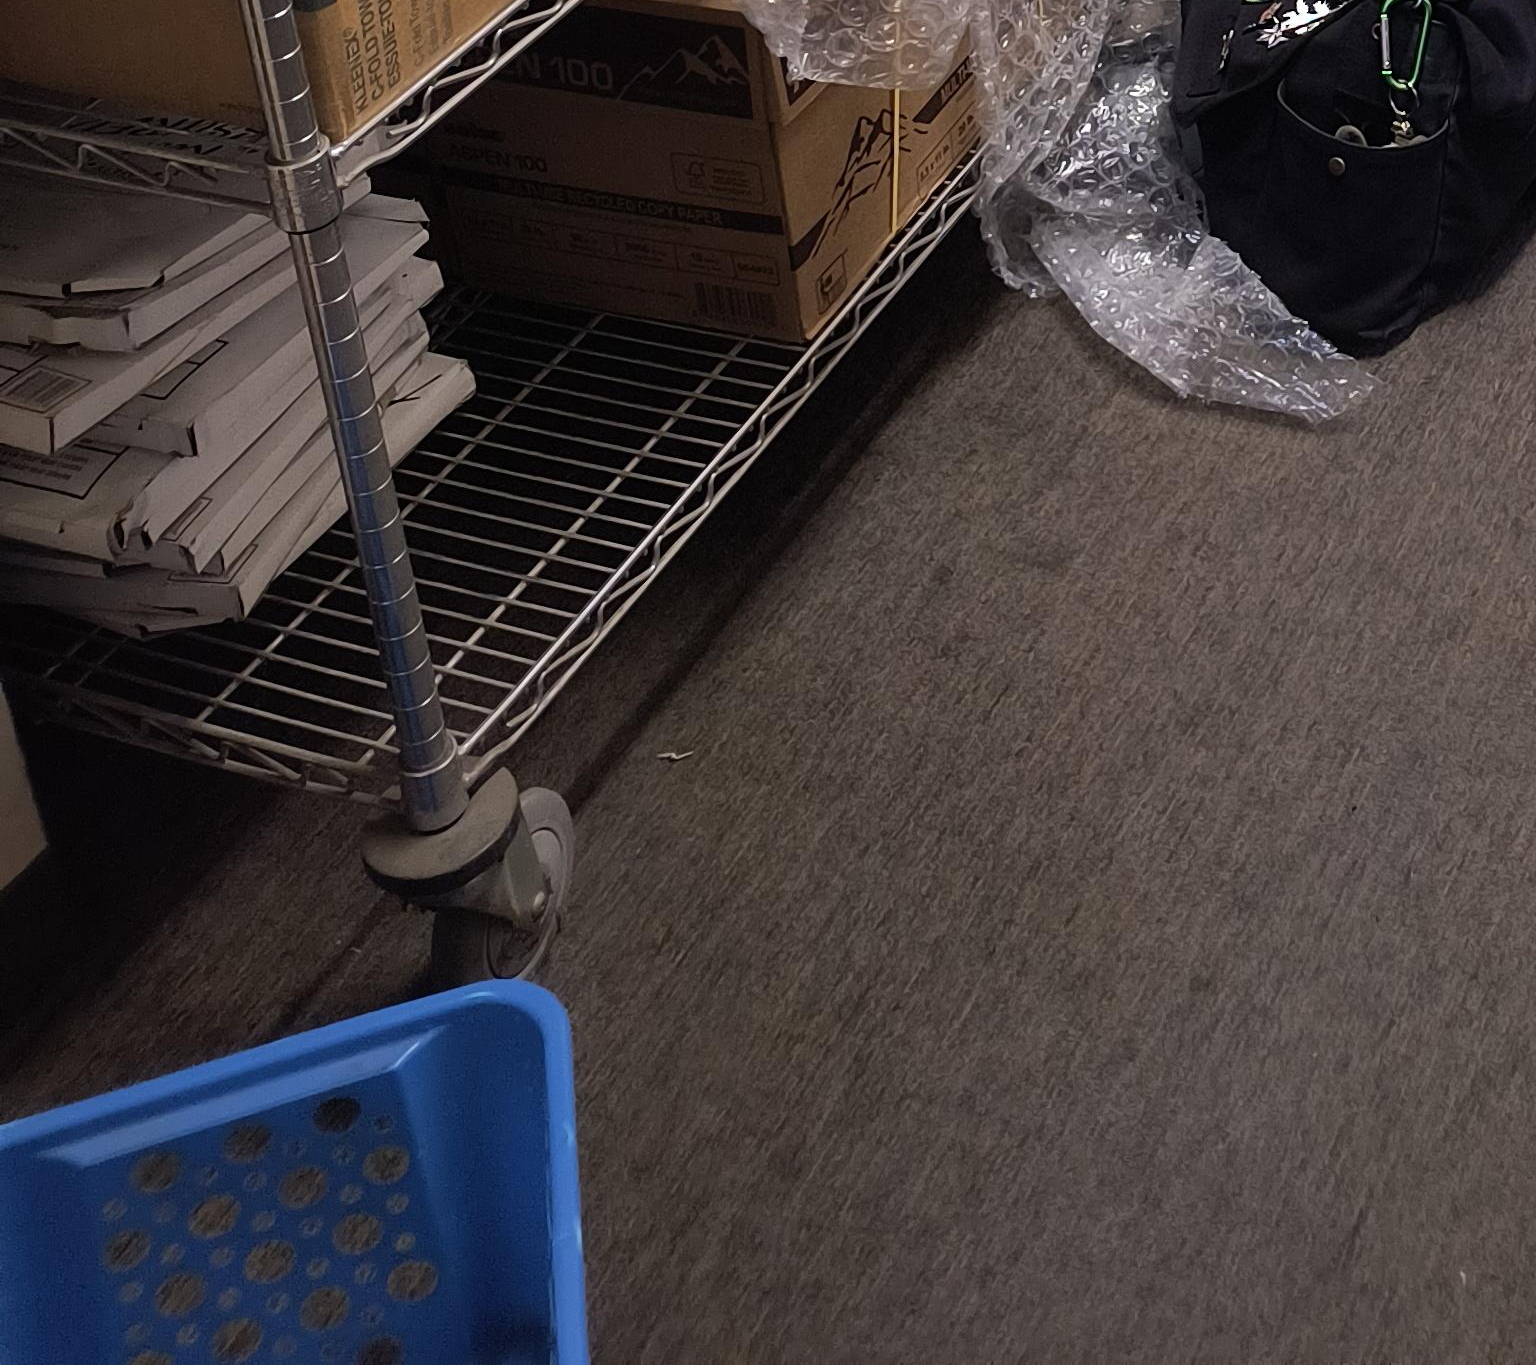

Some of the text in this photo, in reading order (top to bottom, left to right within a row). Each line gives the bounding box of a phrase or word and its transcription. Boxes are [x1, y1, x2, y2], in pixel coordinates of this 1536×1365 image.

[410, 25, 428, 67] C-Fold
[363, 37, 385, 101] C-FOLD
[549, 55, 614, 91] 100
[515, 154, 548, 173] 100
[678, 206, 722, 226] PAPER
